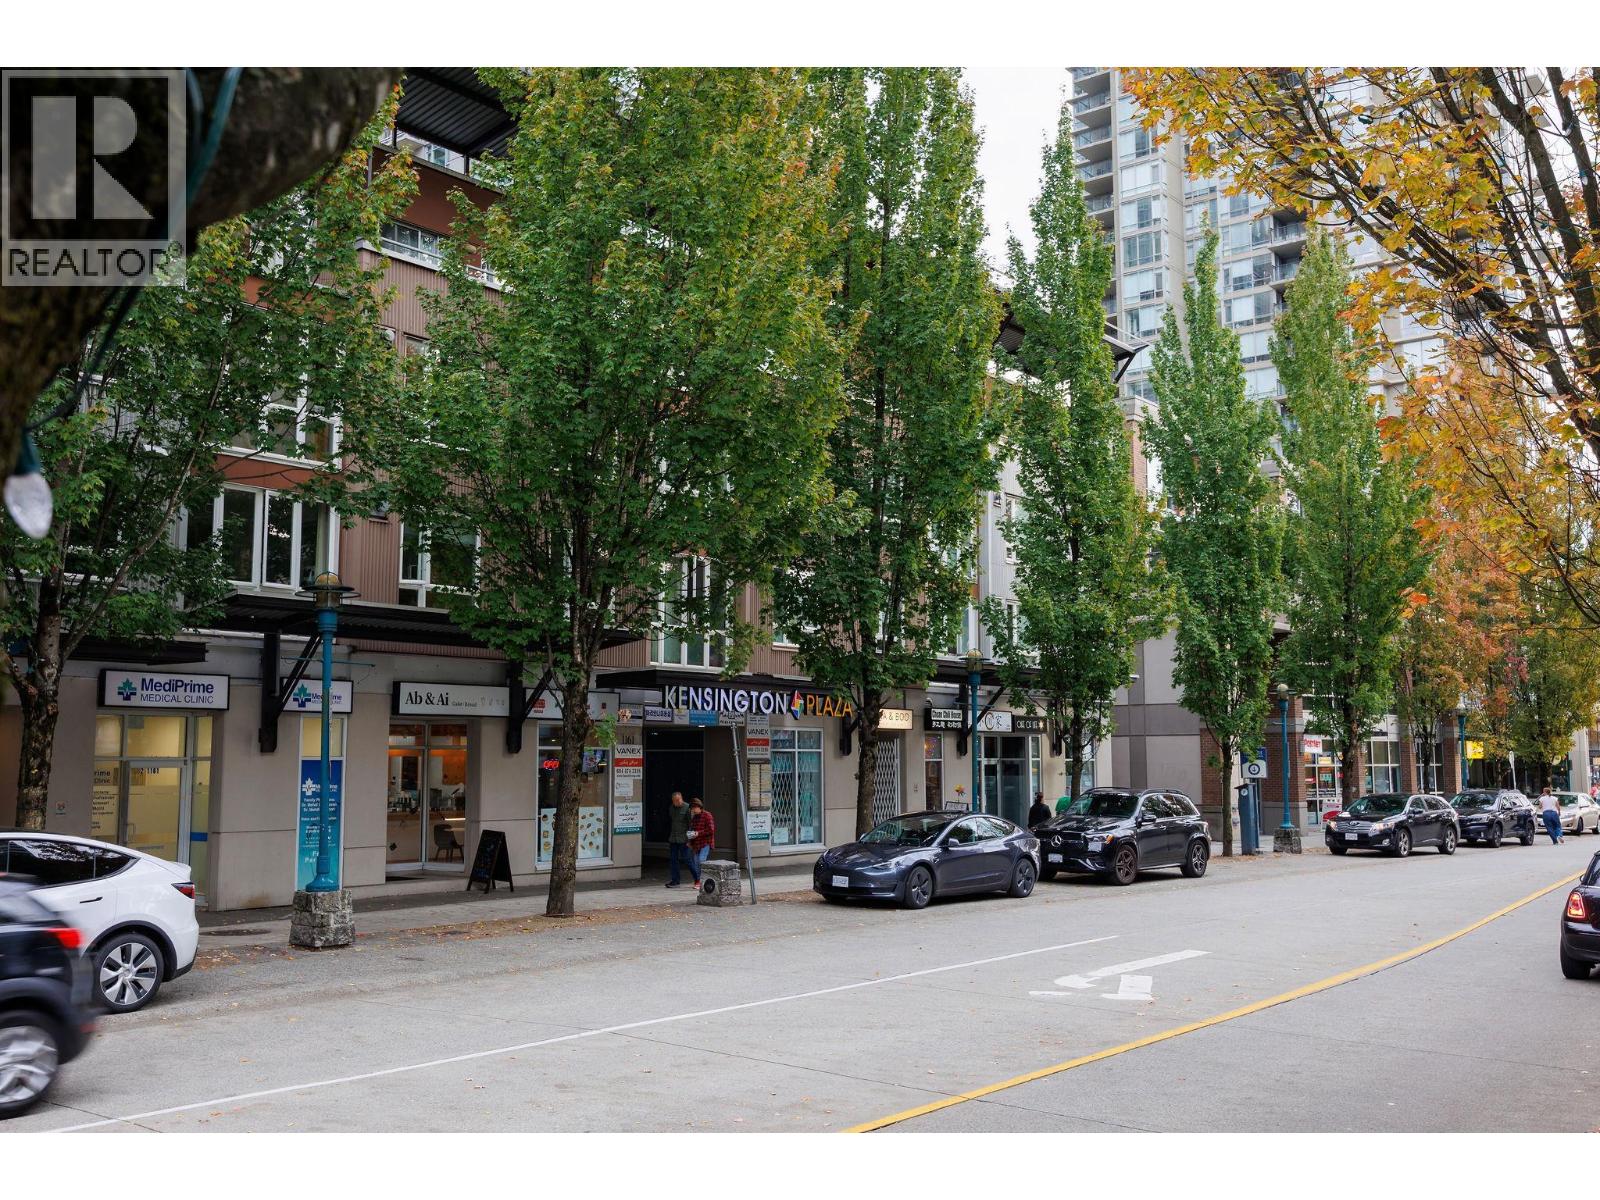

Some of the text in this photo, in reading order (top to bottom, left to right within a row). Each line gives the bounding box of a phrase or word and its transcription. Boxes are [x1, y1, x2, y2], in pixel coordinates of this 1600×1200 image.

[140, 677, 215, 694] MediPrime
[140, 693, 214, 704] MEDICAL CLINIC
[405, 691, 449, 706] Ab & Ai
[664, 685, 787, 715] KENSINGTON
[806, 694, 853, 718] PLAZA
[616, 747, 641, 755] VANEX
